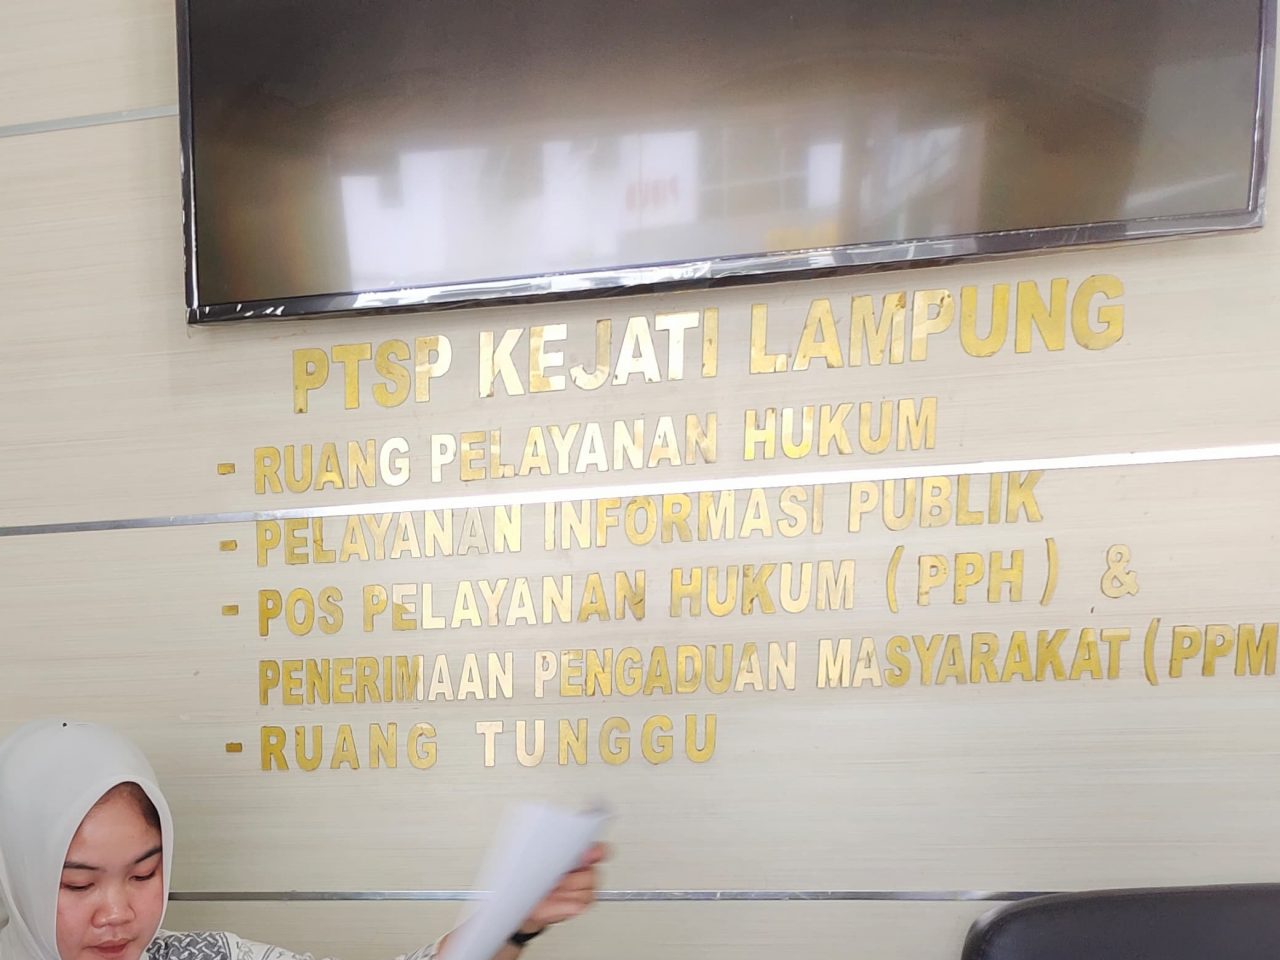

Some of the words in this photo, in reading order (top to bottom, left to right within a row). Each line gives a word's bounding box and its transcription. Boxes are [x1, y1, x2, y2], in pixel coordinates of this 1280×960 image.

[292, 334, 452, 414] PTSP
[478, 307, 718, 398] KEJATI
[749, 274, 1124, 374] LAMPUNG
[254, 436, 411, 494] RUANG
[431, 412, 718, 483] PELAYANAN
[743, 396, 937, 460] HUKUM
[257, 503, 522, 567] PELAYANAN
[544, 485, 823, 551] INFORMASI
[848, 471, 1044, 533] PUBLIK
[258, 586, 344, 636] POS
[362, 570, 646, 632] PELAYANAN
[670, 558, 855, 617] HUKUM
[1100, 543, 1139, 599] &
[259, 652, 514, 706] PENERIMAAN
[534, 639, 797, 699] PENGADUAN
[817, 627, 1131, 689] MASYARAKAT
[260, 721, 438, 771] RUANG
[475, 713, 718, 767] TUNGGU
